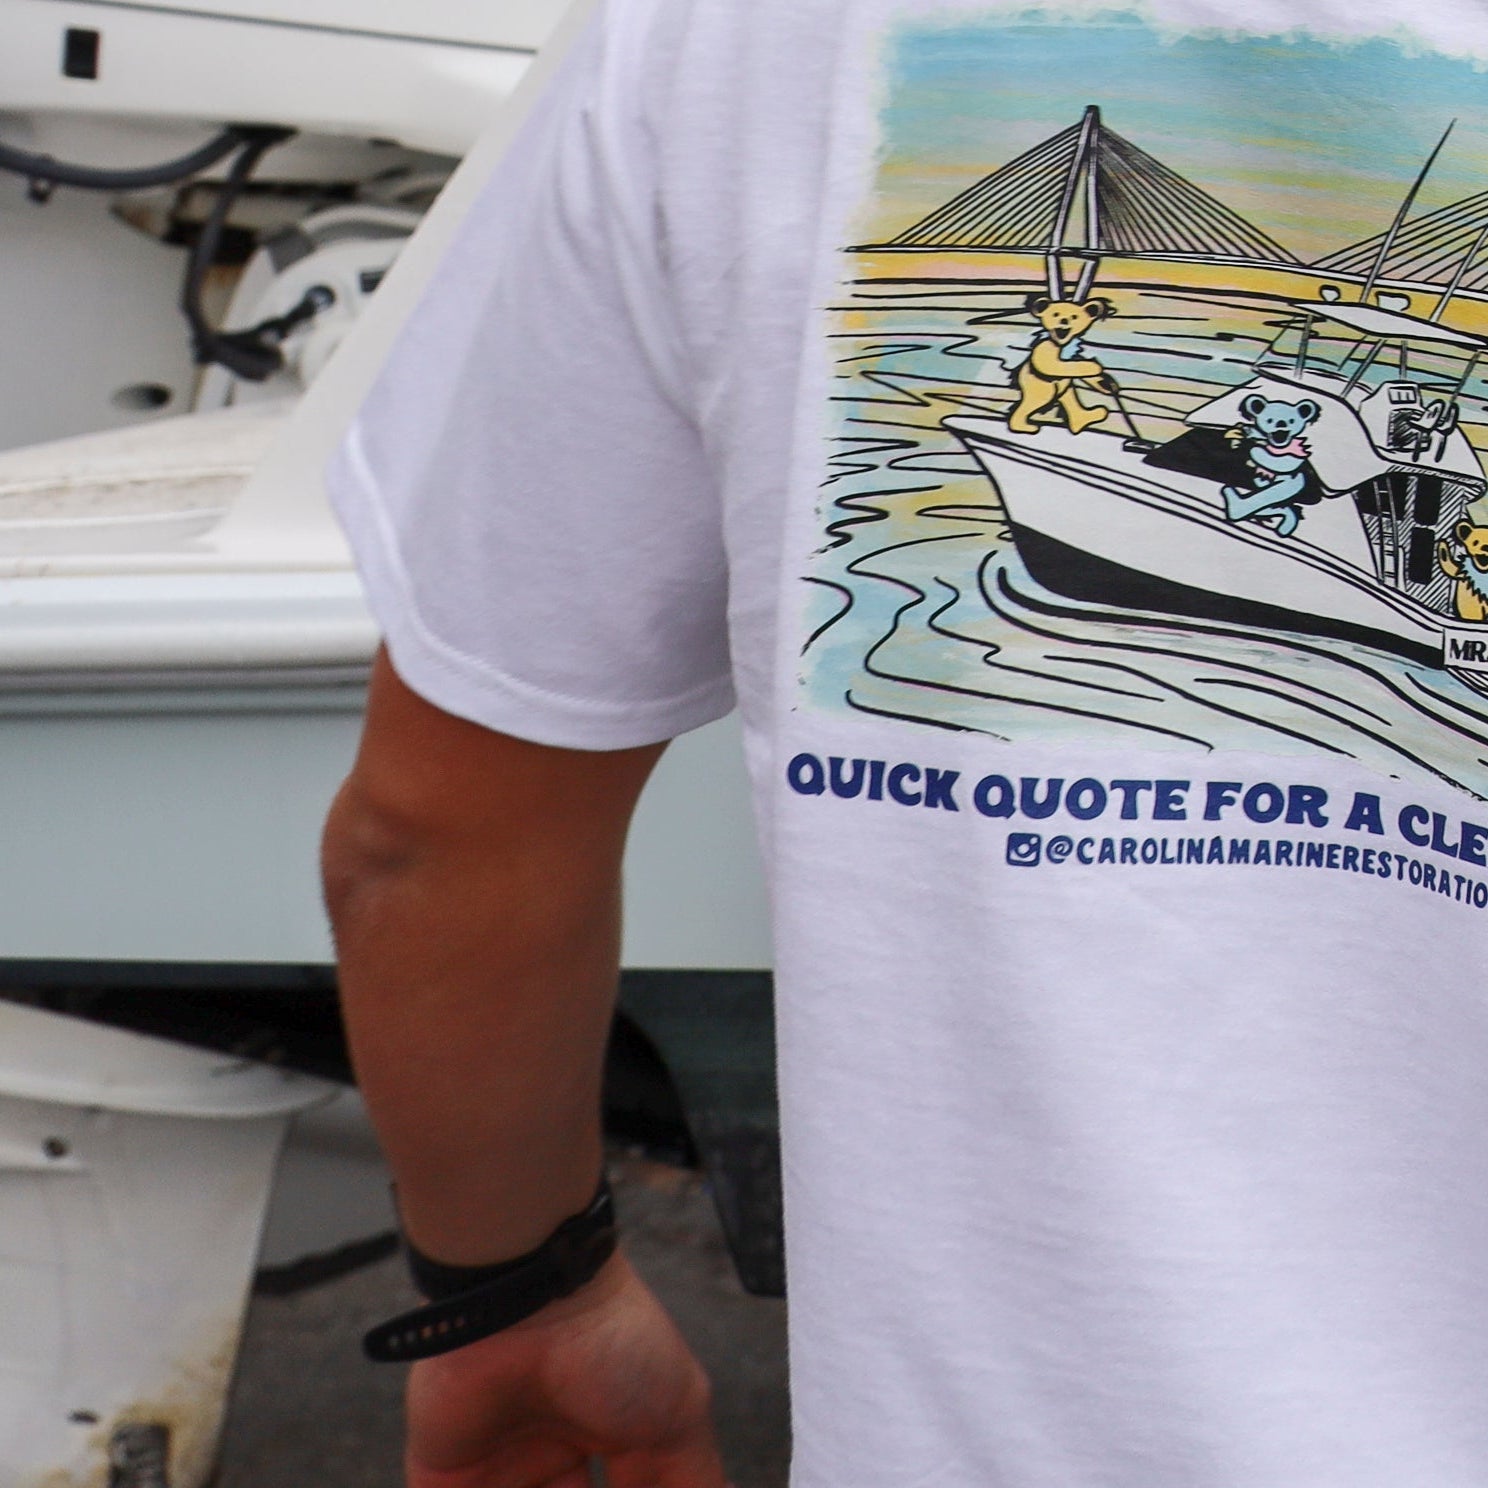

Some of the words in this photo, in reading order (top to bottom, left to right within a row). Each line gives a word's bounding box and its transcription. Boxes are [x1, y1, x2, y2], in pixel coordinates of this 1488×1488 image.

[787, 752, 960, 812] QUICK
[973, 774, 1190, 821] QUOTE
[1203, 781, 1329, 828] FOR
[1344, 791, 1385, 835] A
